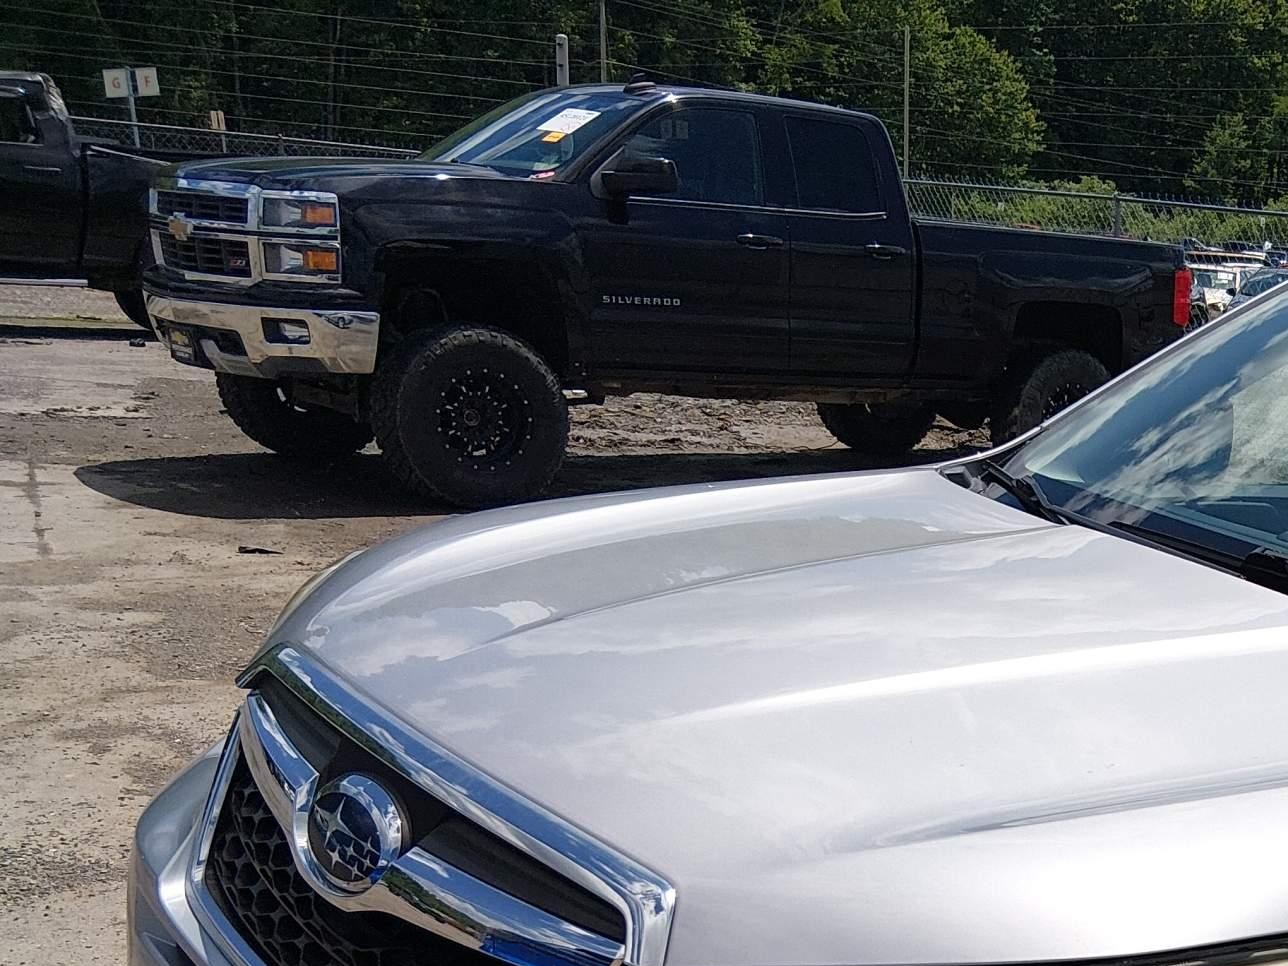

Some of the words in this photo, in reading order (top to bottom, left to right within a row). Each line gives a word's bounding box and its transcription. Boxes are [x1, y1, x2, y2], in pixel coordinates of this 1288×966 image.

[111, 76, 121, 89] G
[143, 75, 152, 88] F
[602, 295, 681, 306] SILVERADO
